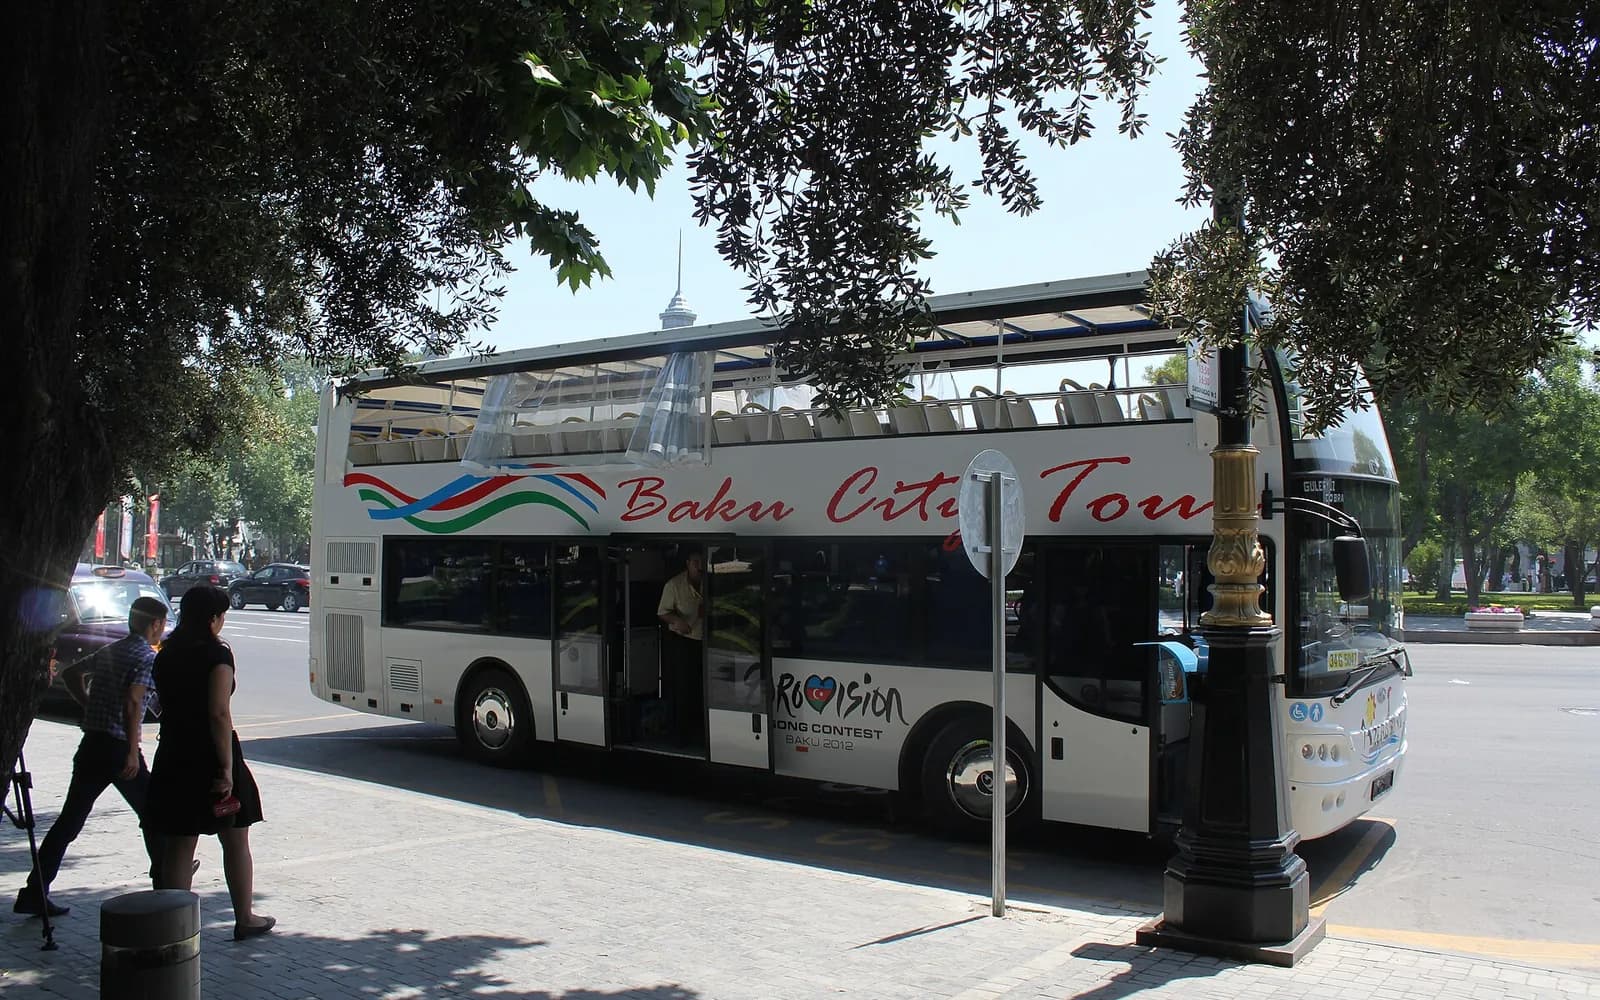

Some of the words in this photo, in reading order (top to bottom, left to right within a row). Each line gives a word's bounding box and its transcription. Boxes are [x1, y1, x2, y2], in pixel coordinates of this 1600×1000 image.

[617, 474, 793, 523] Baku
[1039, 455, 1216, 523] Tou
[811, 723, 883, 740] CONTEST
[785, 734, 820, 747] BAKU
[823, 738, 854, 751] 2012
